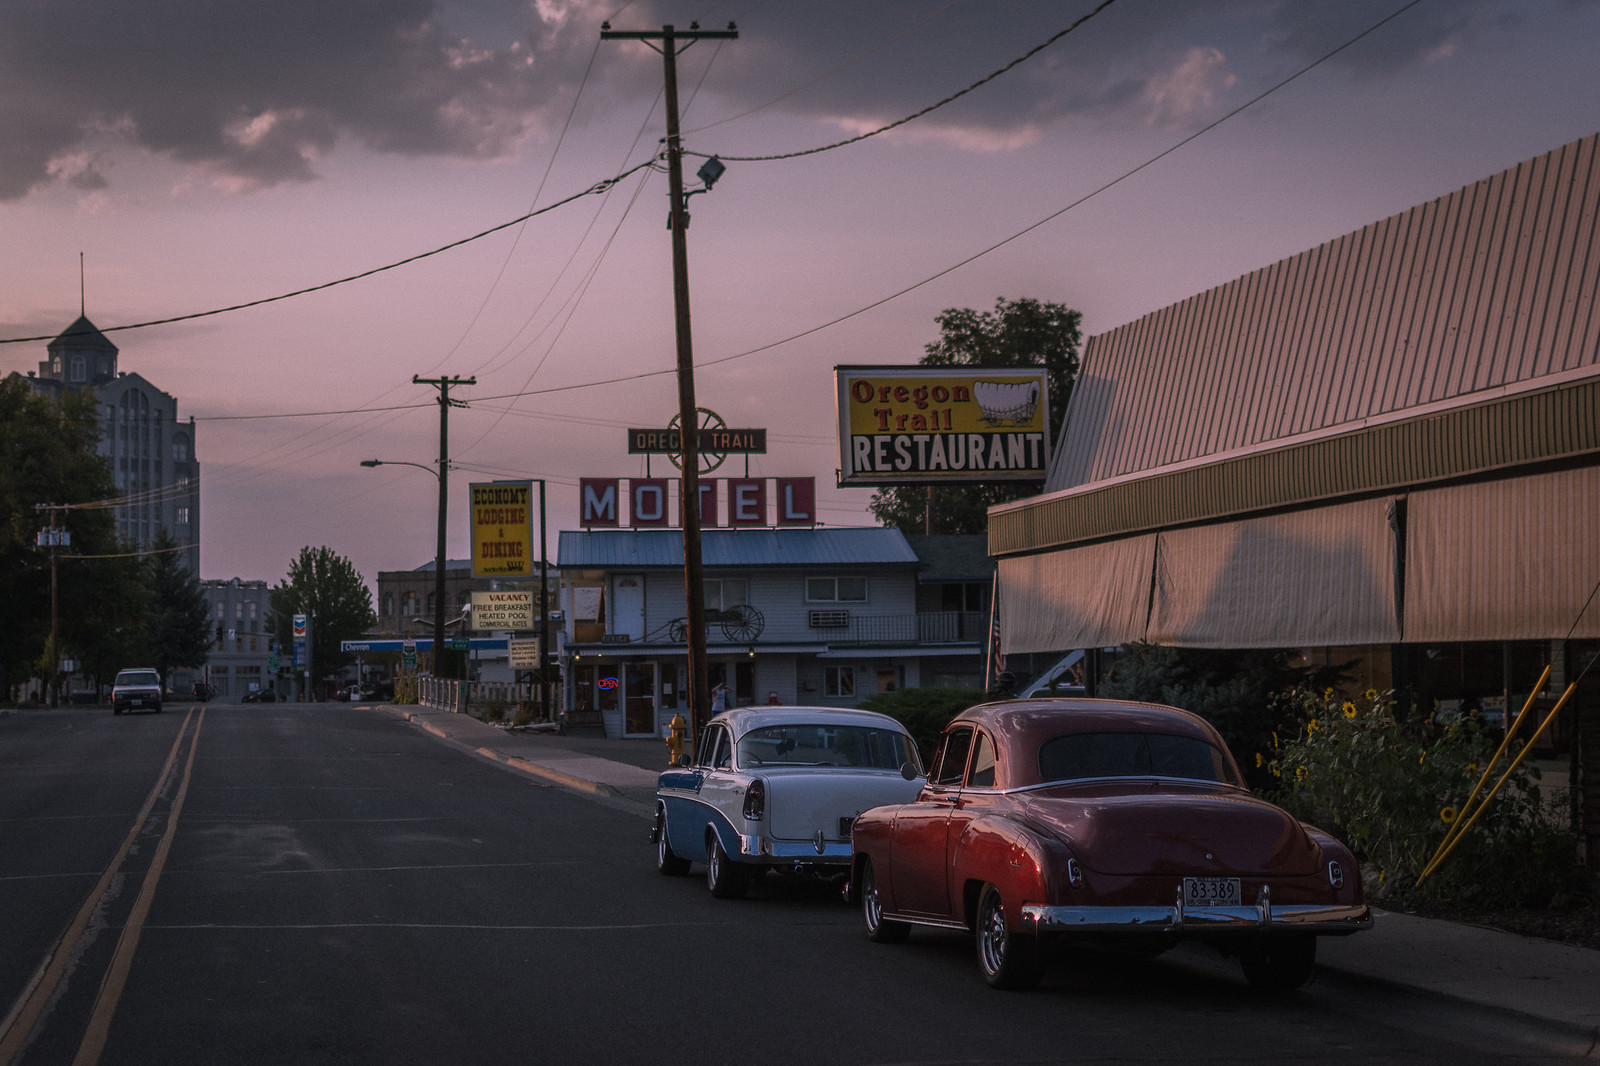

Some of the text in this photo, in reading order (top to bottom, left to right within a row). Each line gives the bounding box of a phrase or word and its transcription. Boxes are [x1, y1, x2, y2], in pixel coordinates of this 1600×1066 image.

[852, 380, 970, 409] Oregon
[874, 408, 952, 432] Trail
[636, 433, 757, 450] OREG TRAIL
[853, 433, 1043, 472] RESTAURANT
[474, 488, 527, 505] ECONOMY
[477, 508, 525, 525] LODGING
[498, 529, 505, 538] &
[481, 541, 522, 558] DINING
[473, 604, 493, 612] FREE
[345, 643, 370, 651] Chevron
[598, 680, 618, 688] OPEN
